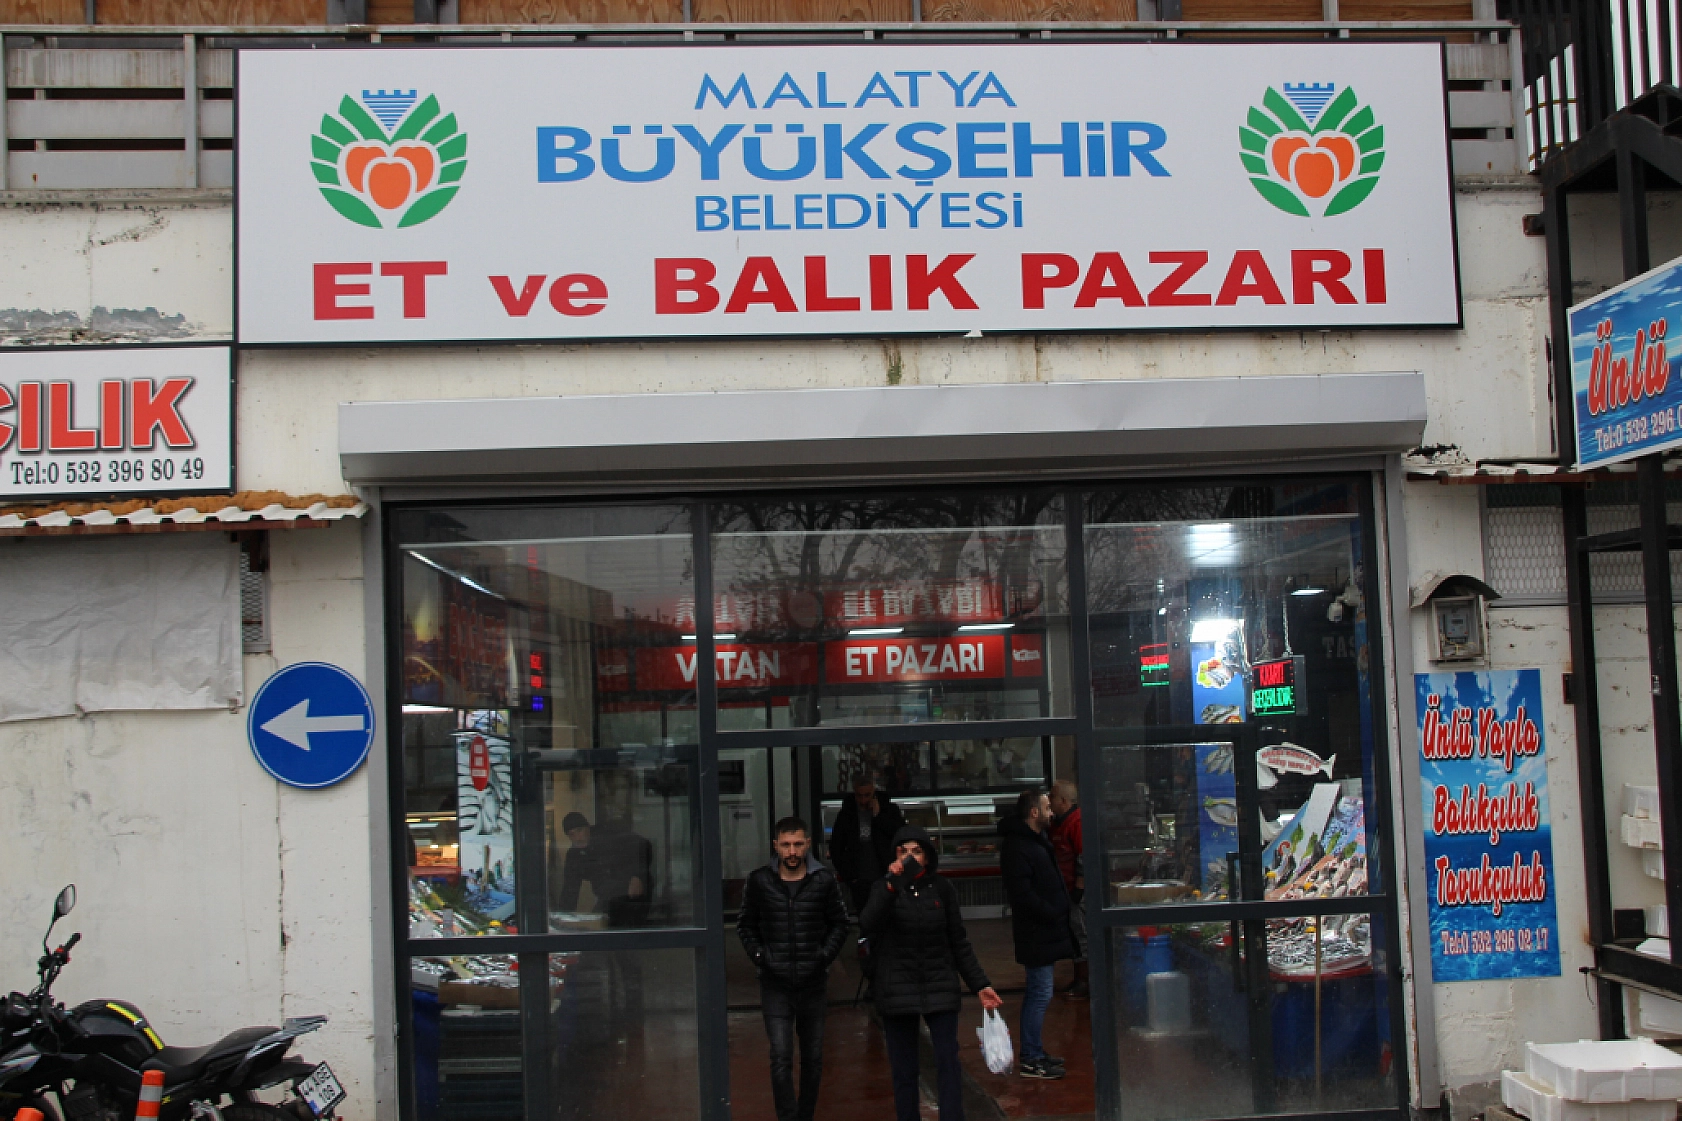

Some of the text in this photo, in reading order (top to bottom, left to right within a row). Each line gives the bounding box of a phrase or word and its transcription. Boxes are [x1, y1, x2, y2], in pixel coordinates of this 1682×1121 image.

[694, 71, 1017, 110] MALATYA
[312, 248, 1388, 321] ET ve BALIK PAZARI
[1588, 317, 1670, 416] Ünlü
[1626, 416, 1649, 445] 532
[1651, 407, 1675, 437] 296
[66, 460, 102, 485] 532
[108, 458, 145, 484] 396
[151, 458, 175, 482] 80
[180, 457, 205, 481] 49
[846, 645, 879, 676] ET
[885, 643, 985, 676] PAZARI
[1422, 693, 1540, 773] Ünlü Yayla
[1432, 780, 1539, 846] Balıkçılık
[1435, 850, 1546, 916] Tavukçuluk
[1471, 929, 1492, 954] 532
[1494, 928, 1516, 953] 296
[1535, 927, 1549, 951] 17
